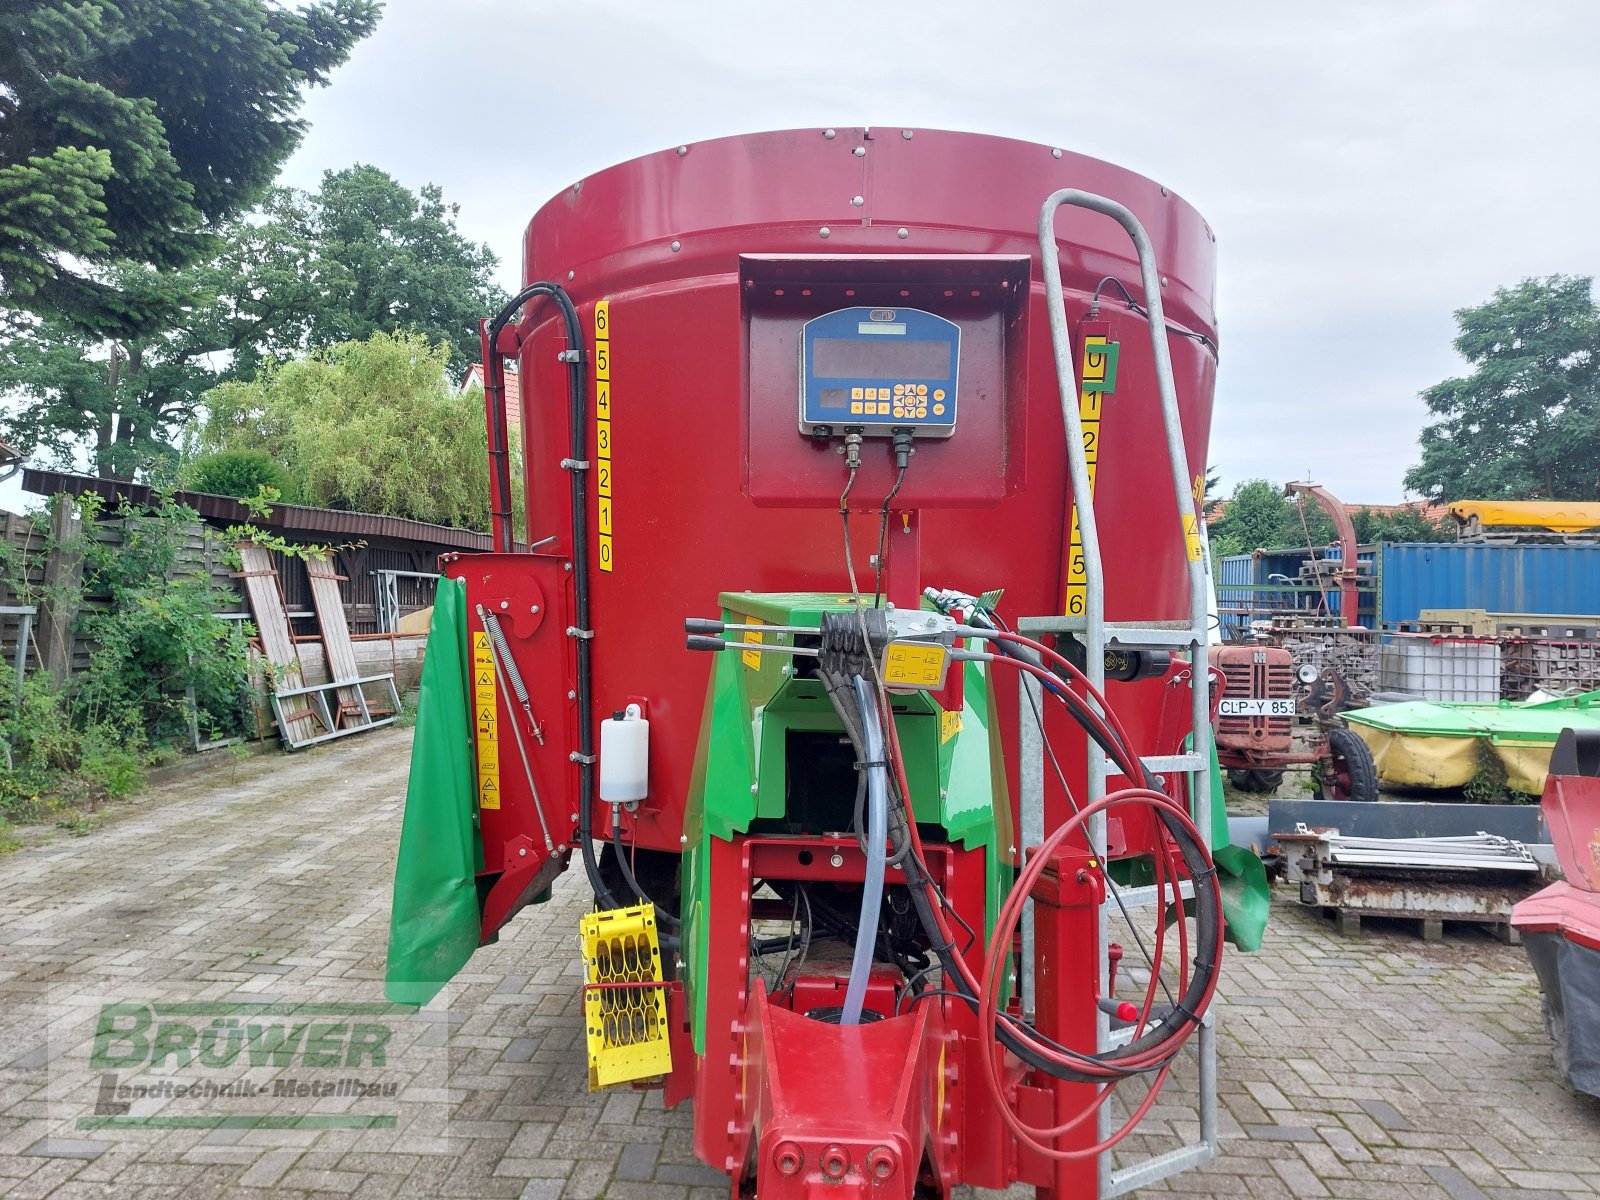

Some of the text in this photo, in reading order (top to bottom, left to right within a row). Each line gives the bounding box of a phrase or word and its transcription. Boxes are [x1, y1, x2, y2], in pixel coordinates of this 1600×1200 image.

[597, 310, 606, 330] 6
[598, 350, 607, 370] 5
[598, 390, 608, 411] 4
[1088, 390, 1097, 410] 1
[599, 429, 608, 449] 3
[1083, 431, 1095, 453] 2
[600, 468, 609, 488] 2
[602, 507, 608, 526] 1
[601, 544, 610, 562] 0
[1072, 556, 1085, 575] 5
[1070, 595, 1083, 614] 6
[1220, 701, 1295, 714] CLP-Y 853
